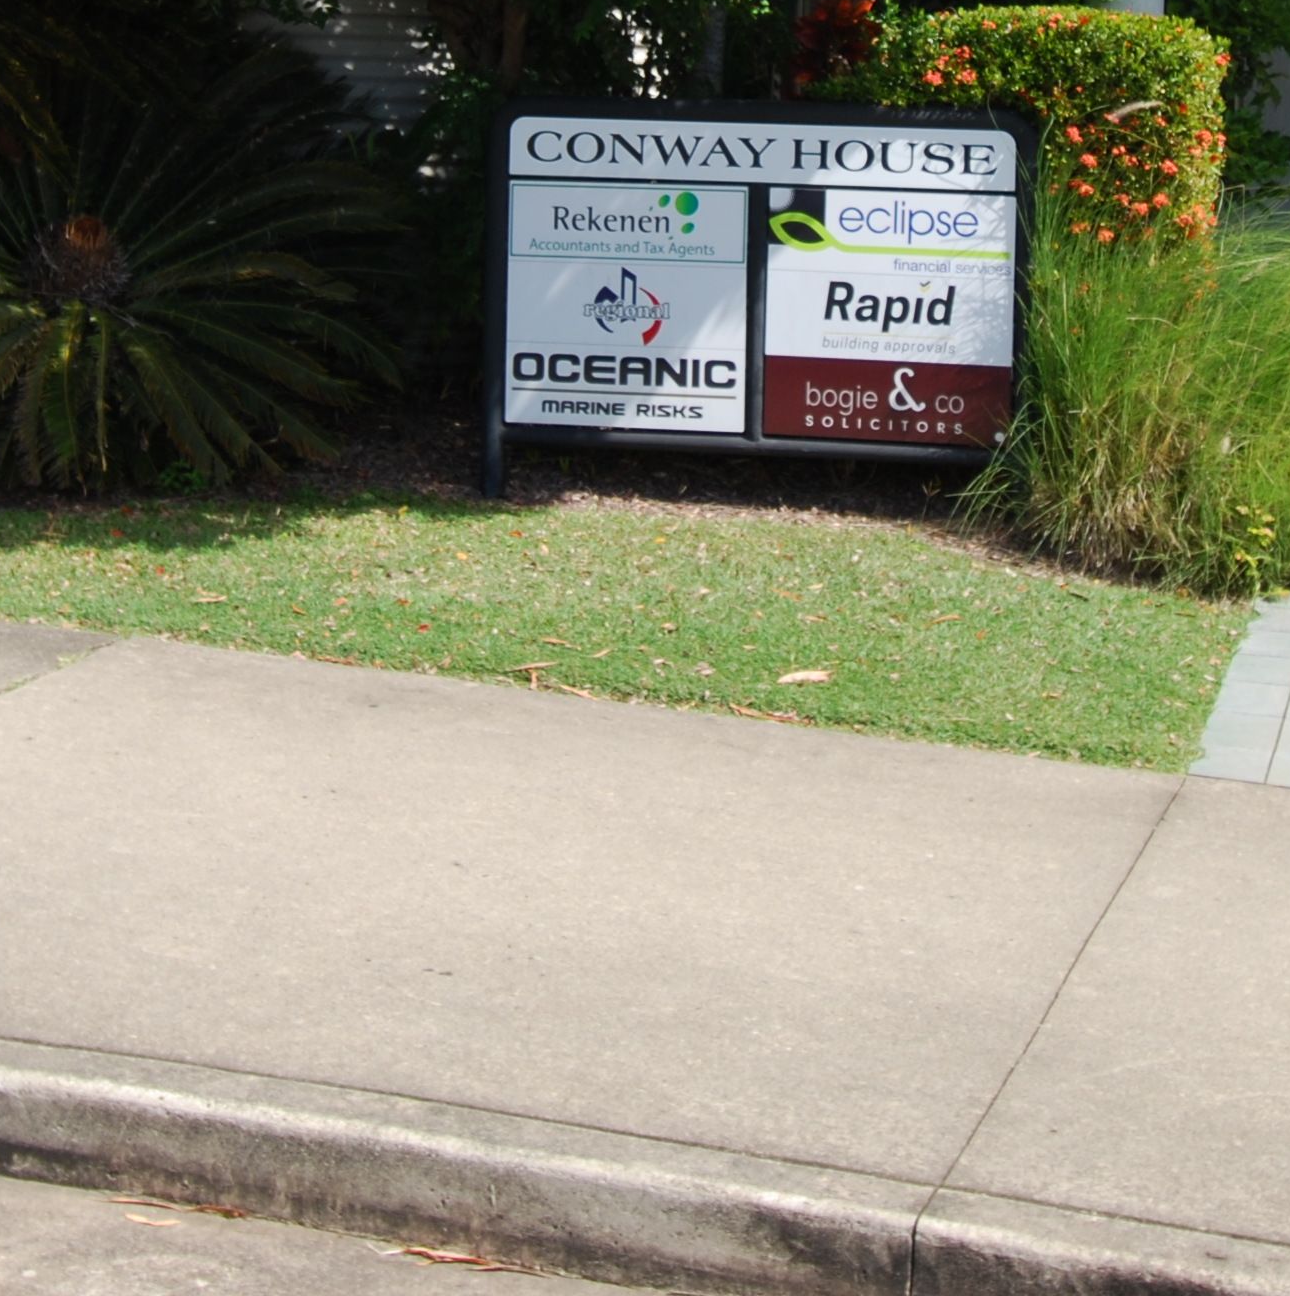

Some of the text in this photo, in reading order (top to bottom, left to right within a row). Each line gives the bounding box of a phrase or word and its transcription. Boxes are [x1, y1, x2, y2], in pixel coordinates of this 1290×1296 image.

[527, 131, 997, 176] CONWAY HOUSE
[553, 206, 670, 233] Rekenen
[839, 201, 979, 245] eclipse
[529, 238, 715, 258] Accountants and Tax Agents
[894, 258, 1012, 275] financial services
[583, 301, 670, 321] regional
[823, 281, 956, 333] Rapid
[822, 335, 957, 354] building approvals
[512, 352, 737, 389] OCEANIC
[805, 381, 879, 416] bogie
[888, 367, 926, 412] &
[541, 399, 703, 419] MARINE RISKS
[805, 415, 963, 435] SOLICITORS
